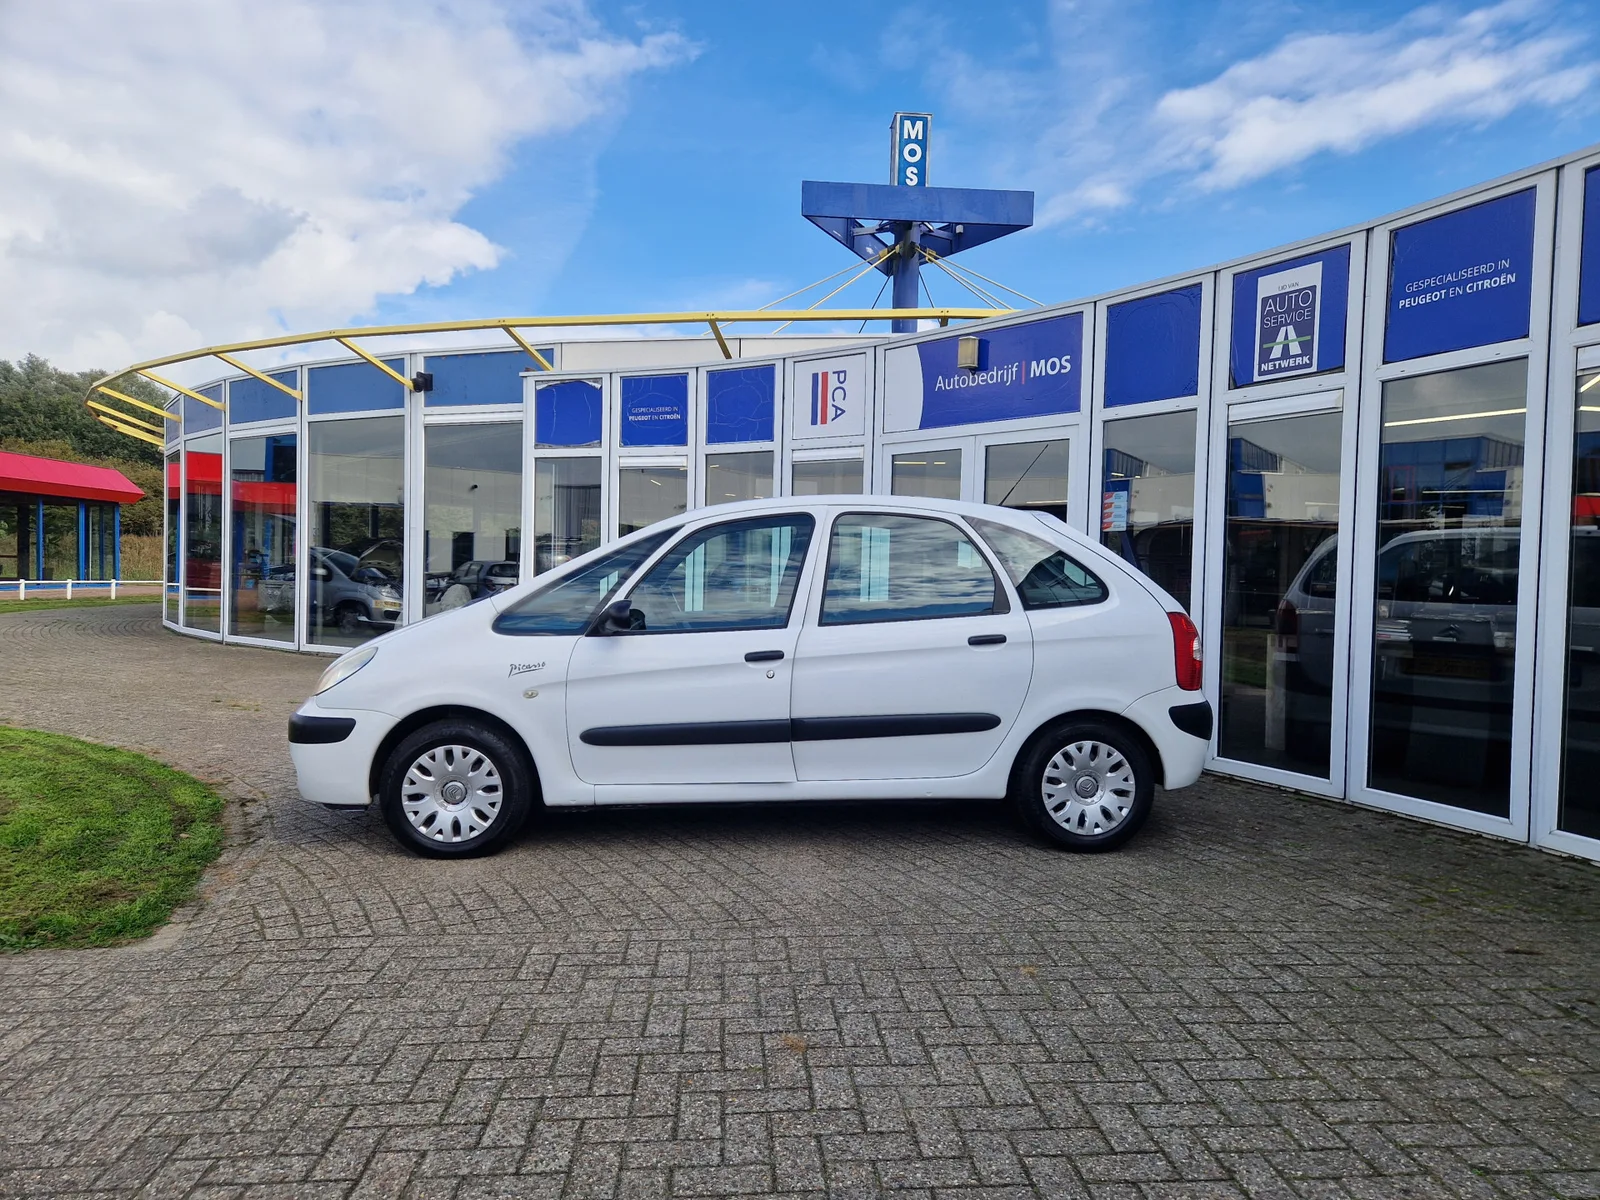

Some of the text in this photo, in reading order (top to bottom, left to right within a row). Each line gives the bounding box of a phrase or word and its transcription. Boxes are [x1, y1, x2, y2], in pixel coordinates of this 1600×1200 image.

[903, 119, 923, 186] MOS
[1288, 281, 1300, 289] VAN
[1398, 272, 1516, 309] PEUGEOT EN CITROËN
[1405, 258, 1510, 293] GESPECIALISEERD IN
[1263, 307, 1312, 329] SERVICE
[1264, 289, 1313, 315] AUTO
[934, 355, 1072, 392] Autobedrijf MOS
[1260, 355, 1310, 372] NETWERK
[831, 369, 847, 421] PCA
